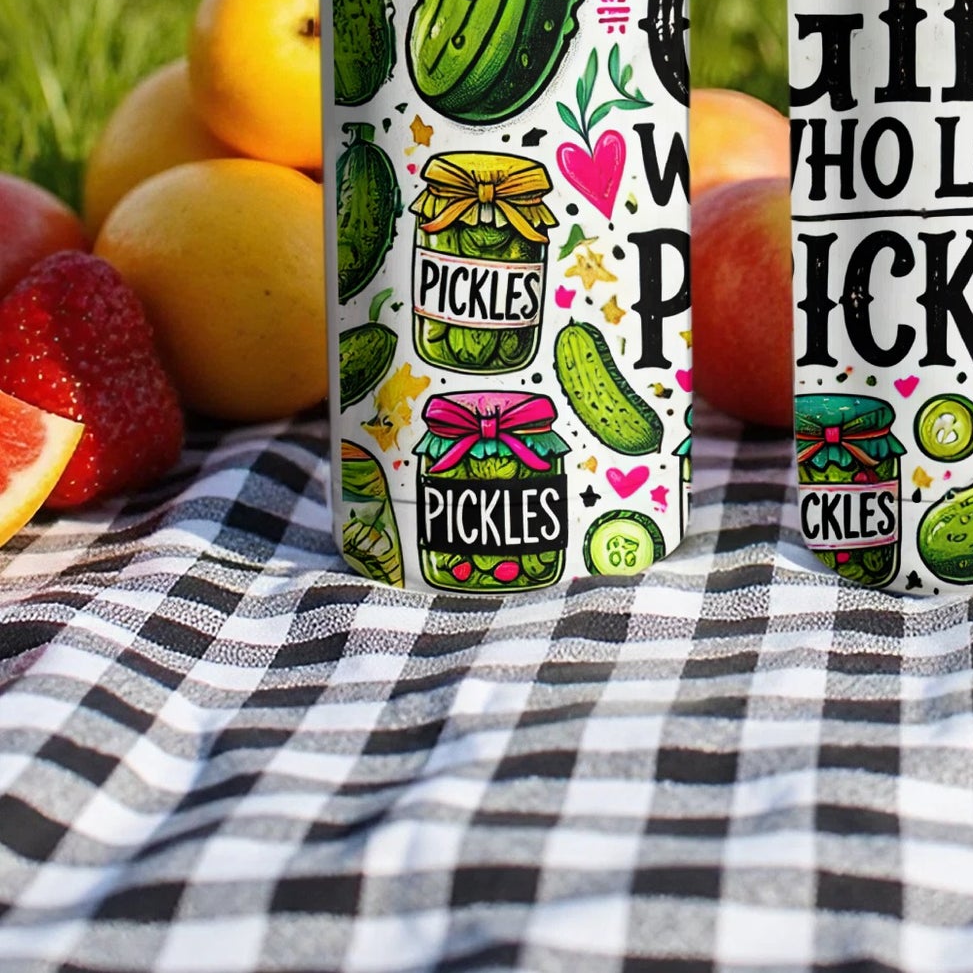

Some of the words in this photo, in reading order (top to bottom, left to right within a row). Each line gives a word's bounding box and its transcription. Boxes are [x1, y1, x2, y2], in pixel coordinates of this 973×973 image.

[420, 259, 540, 320] PICKLES
[424, 487, 561, 546] PICKLES
[801, 491, 896, 540] CKLES
